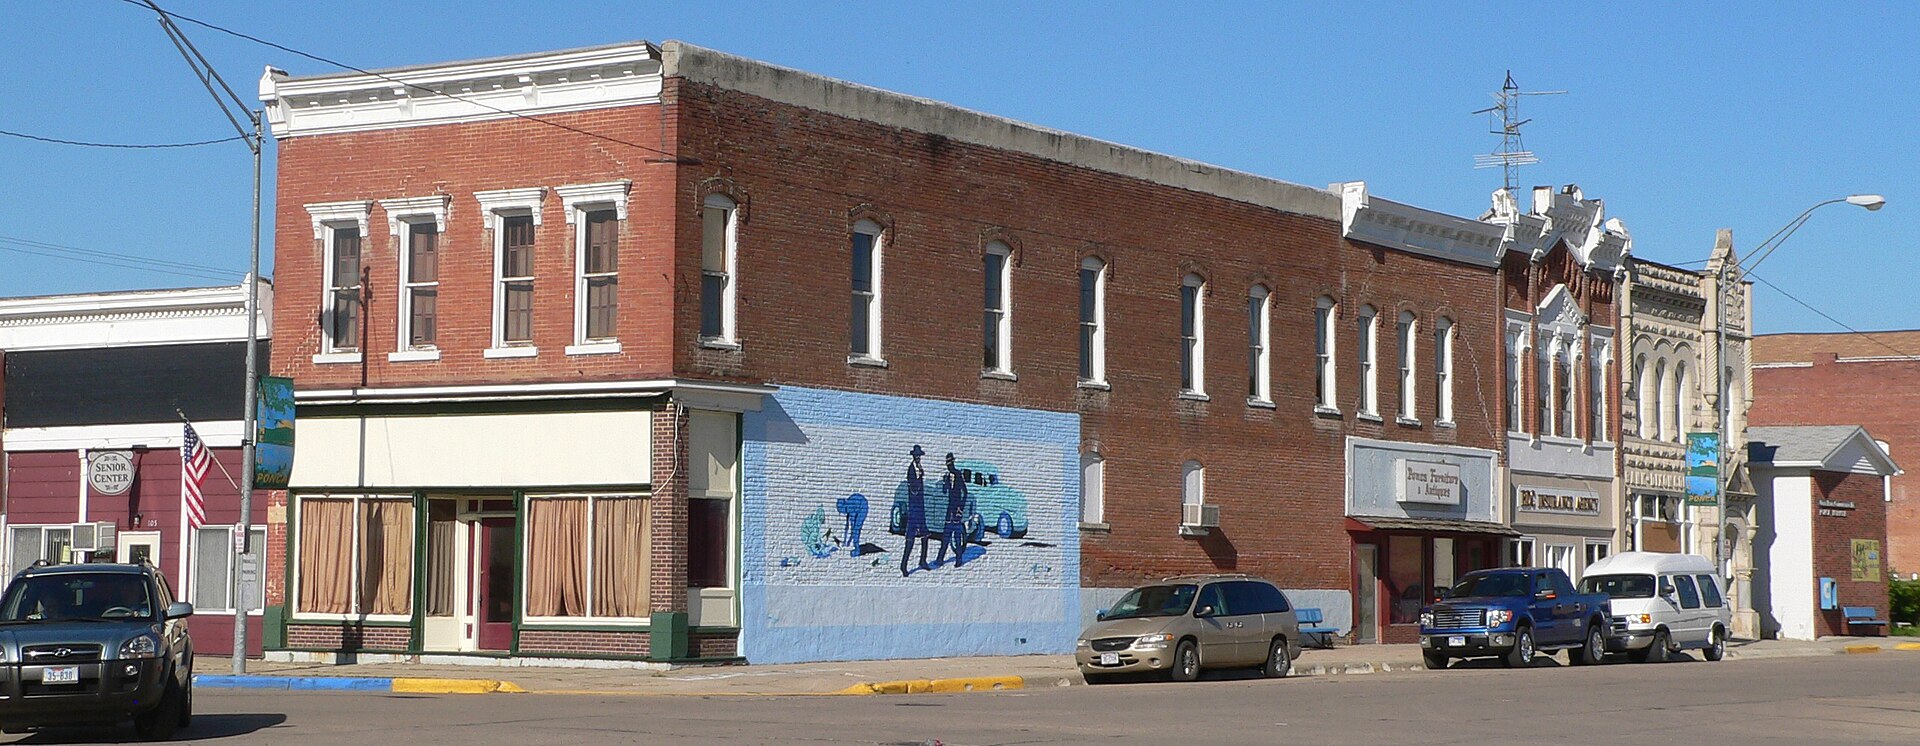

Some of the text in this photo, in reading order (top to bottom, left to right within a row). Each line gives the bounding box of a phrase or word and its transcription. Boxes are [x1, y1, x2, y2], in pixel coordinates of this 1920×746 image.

[95, 462, 127, 472] SENIOR
[94, 474, 129, 483] CENTER
[257, 472, 288, 484] PONCA
[1425, 483, 1451, 500] Antiques
[1538, 494, 1574, 510] INSURANCE
[1575, 496, 1599, 512] AGENCY
[147, 519, 158, 527] 105
